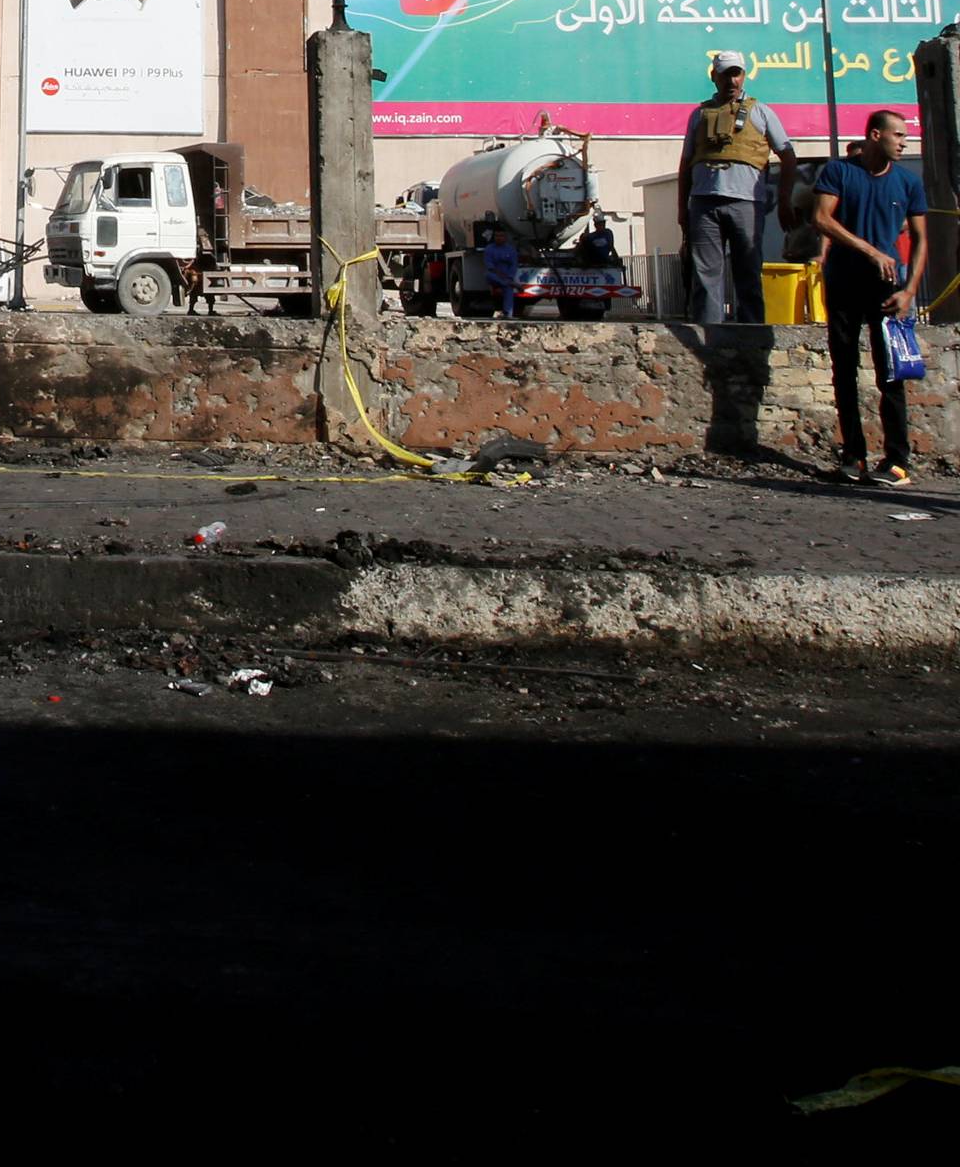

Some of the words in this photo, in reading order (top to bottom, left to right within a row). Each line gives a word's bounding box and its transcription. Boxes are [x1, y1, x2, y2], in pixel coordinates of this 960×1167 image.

[705, 41, 812, 82] السر
[64, 67, 118, 78] HUAWEI
[122, 67, 137, 78] P9
[147, 67, 161, 78] P9
[162, 67, 184, 79] Plus
[371, 112, 463, 127] ww.iq.zain.com
